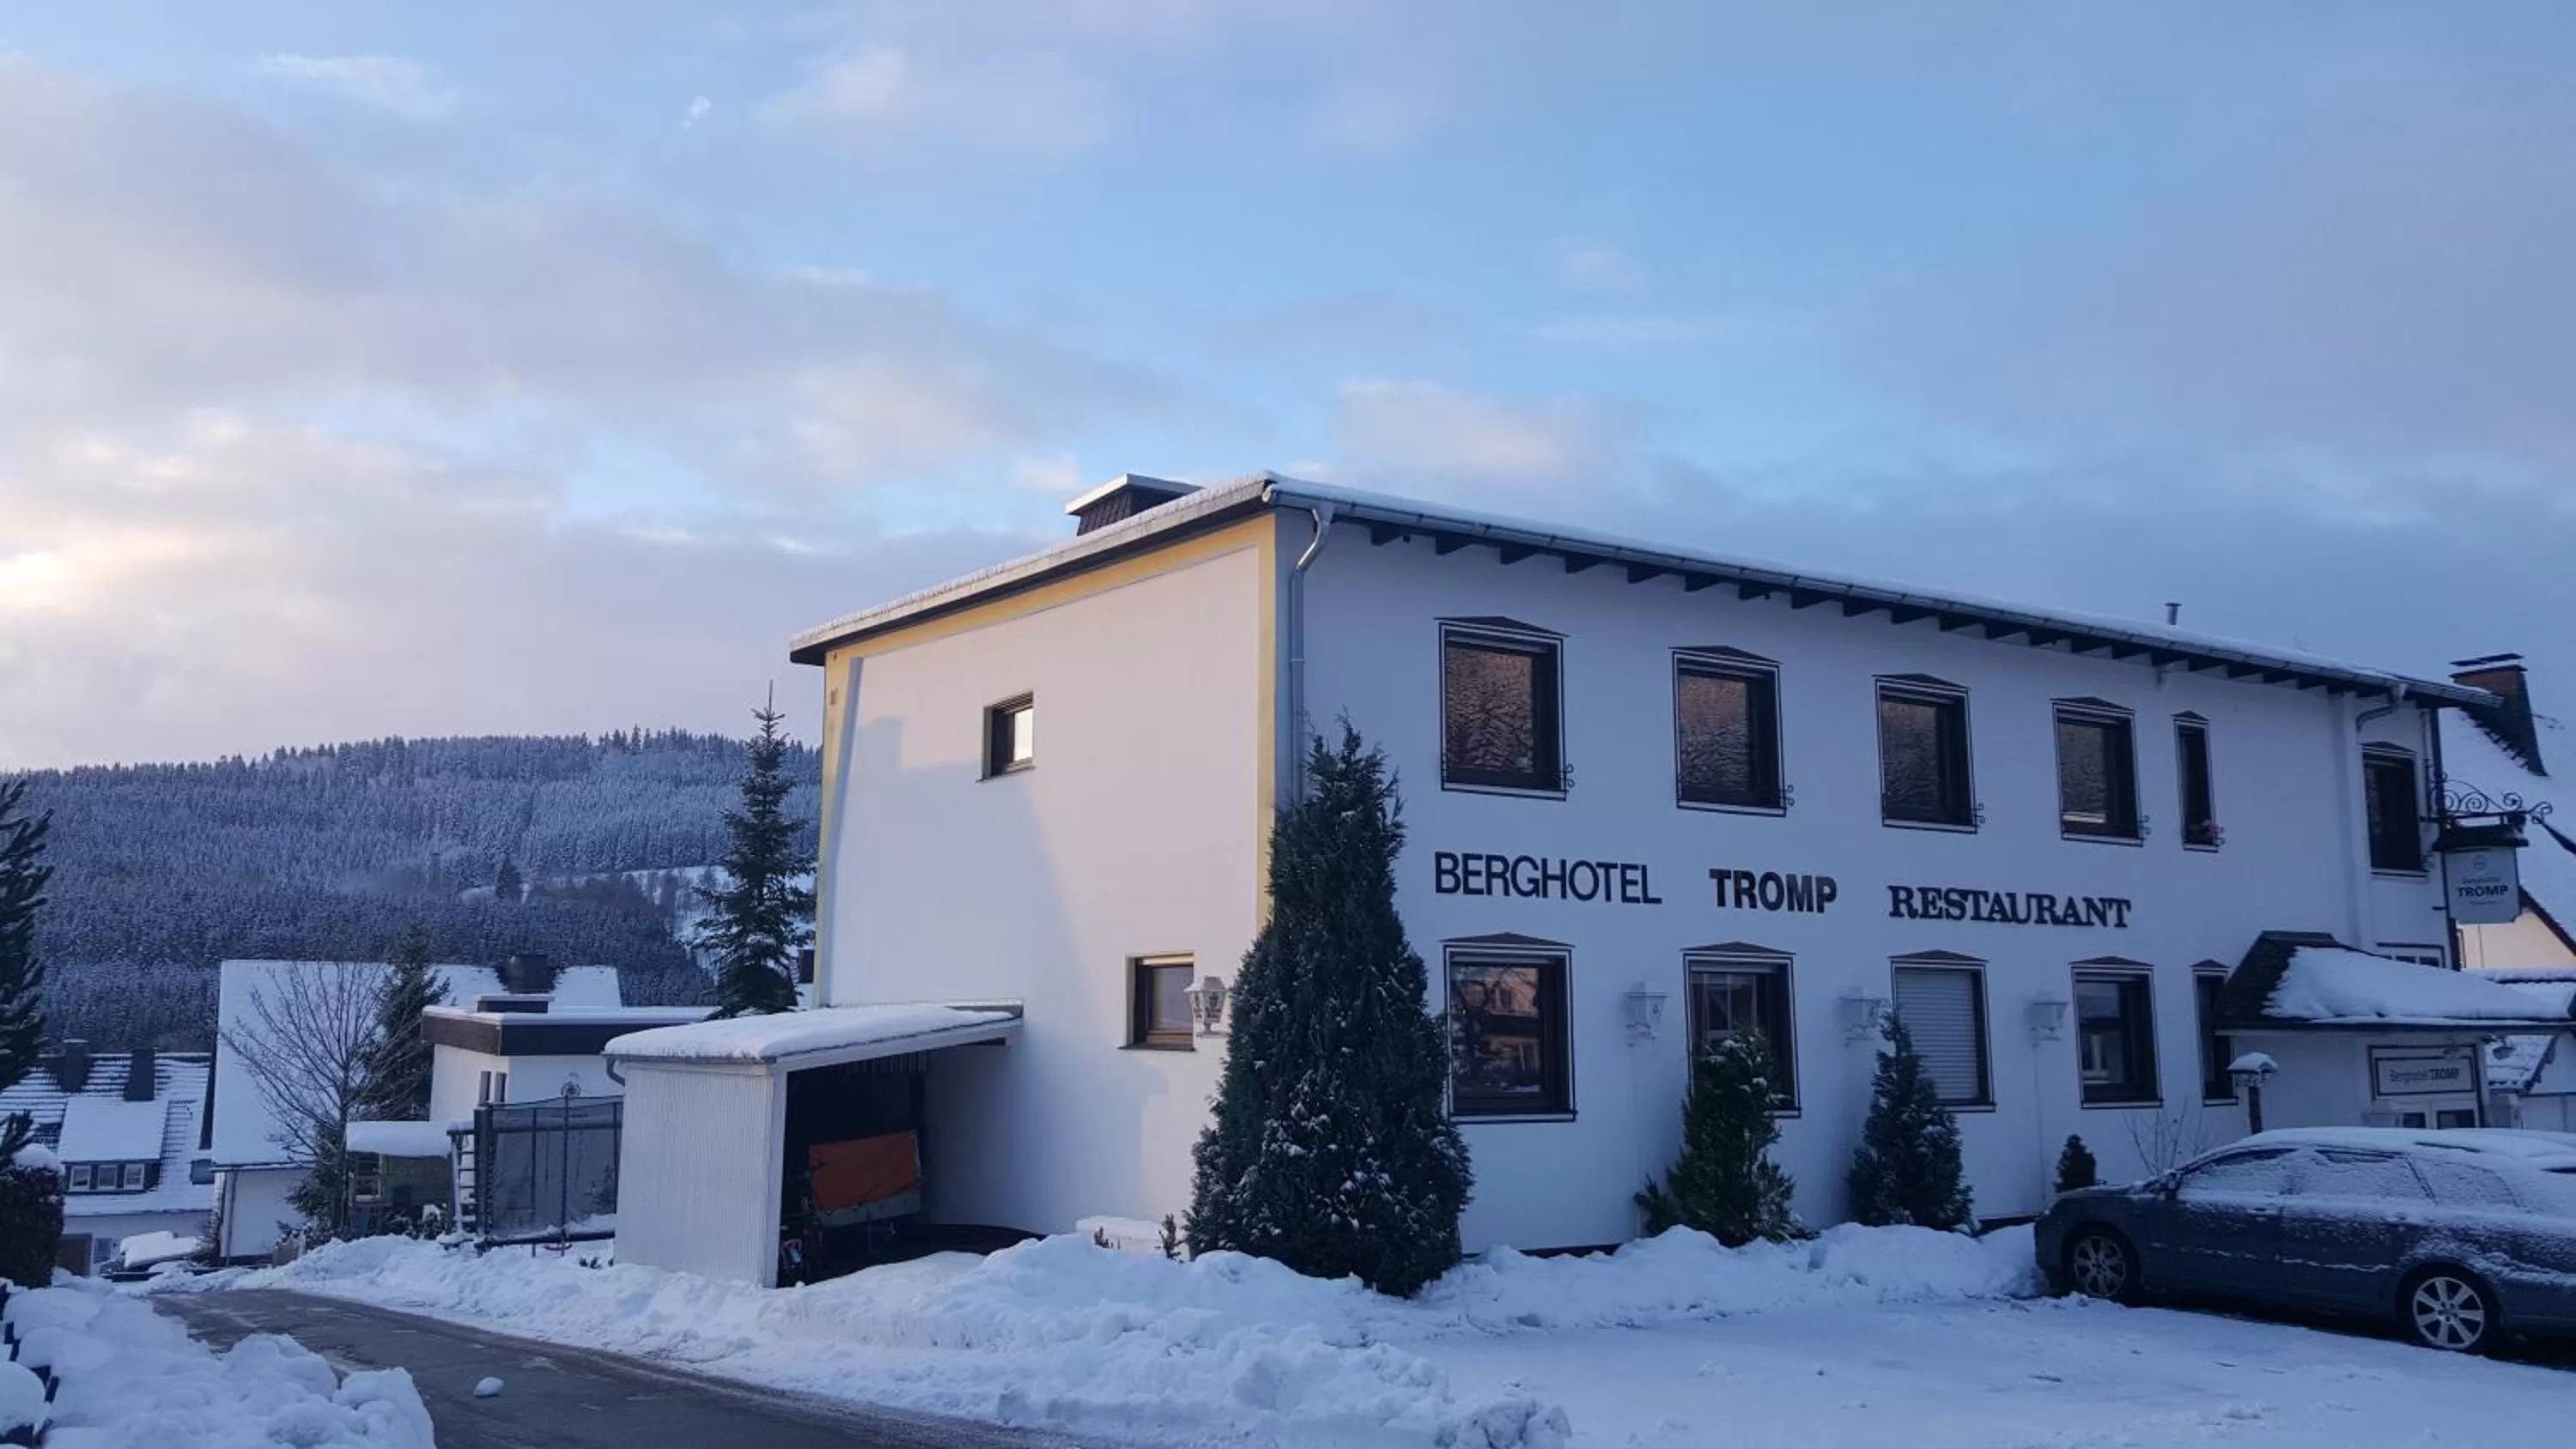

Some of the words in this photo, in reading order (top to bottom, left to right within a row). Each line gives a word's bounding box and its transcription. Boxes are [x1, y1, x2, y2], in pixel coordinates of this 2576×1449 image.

[1435, 851, 1662, 905] BERGHOTEL
[1709, 868, 1838, 913] TROMP
[1887, 885, 2131, 928] RESTAURANT
[2456, 885, 2509, 897] TROMP
